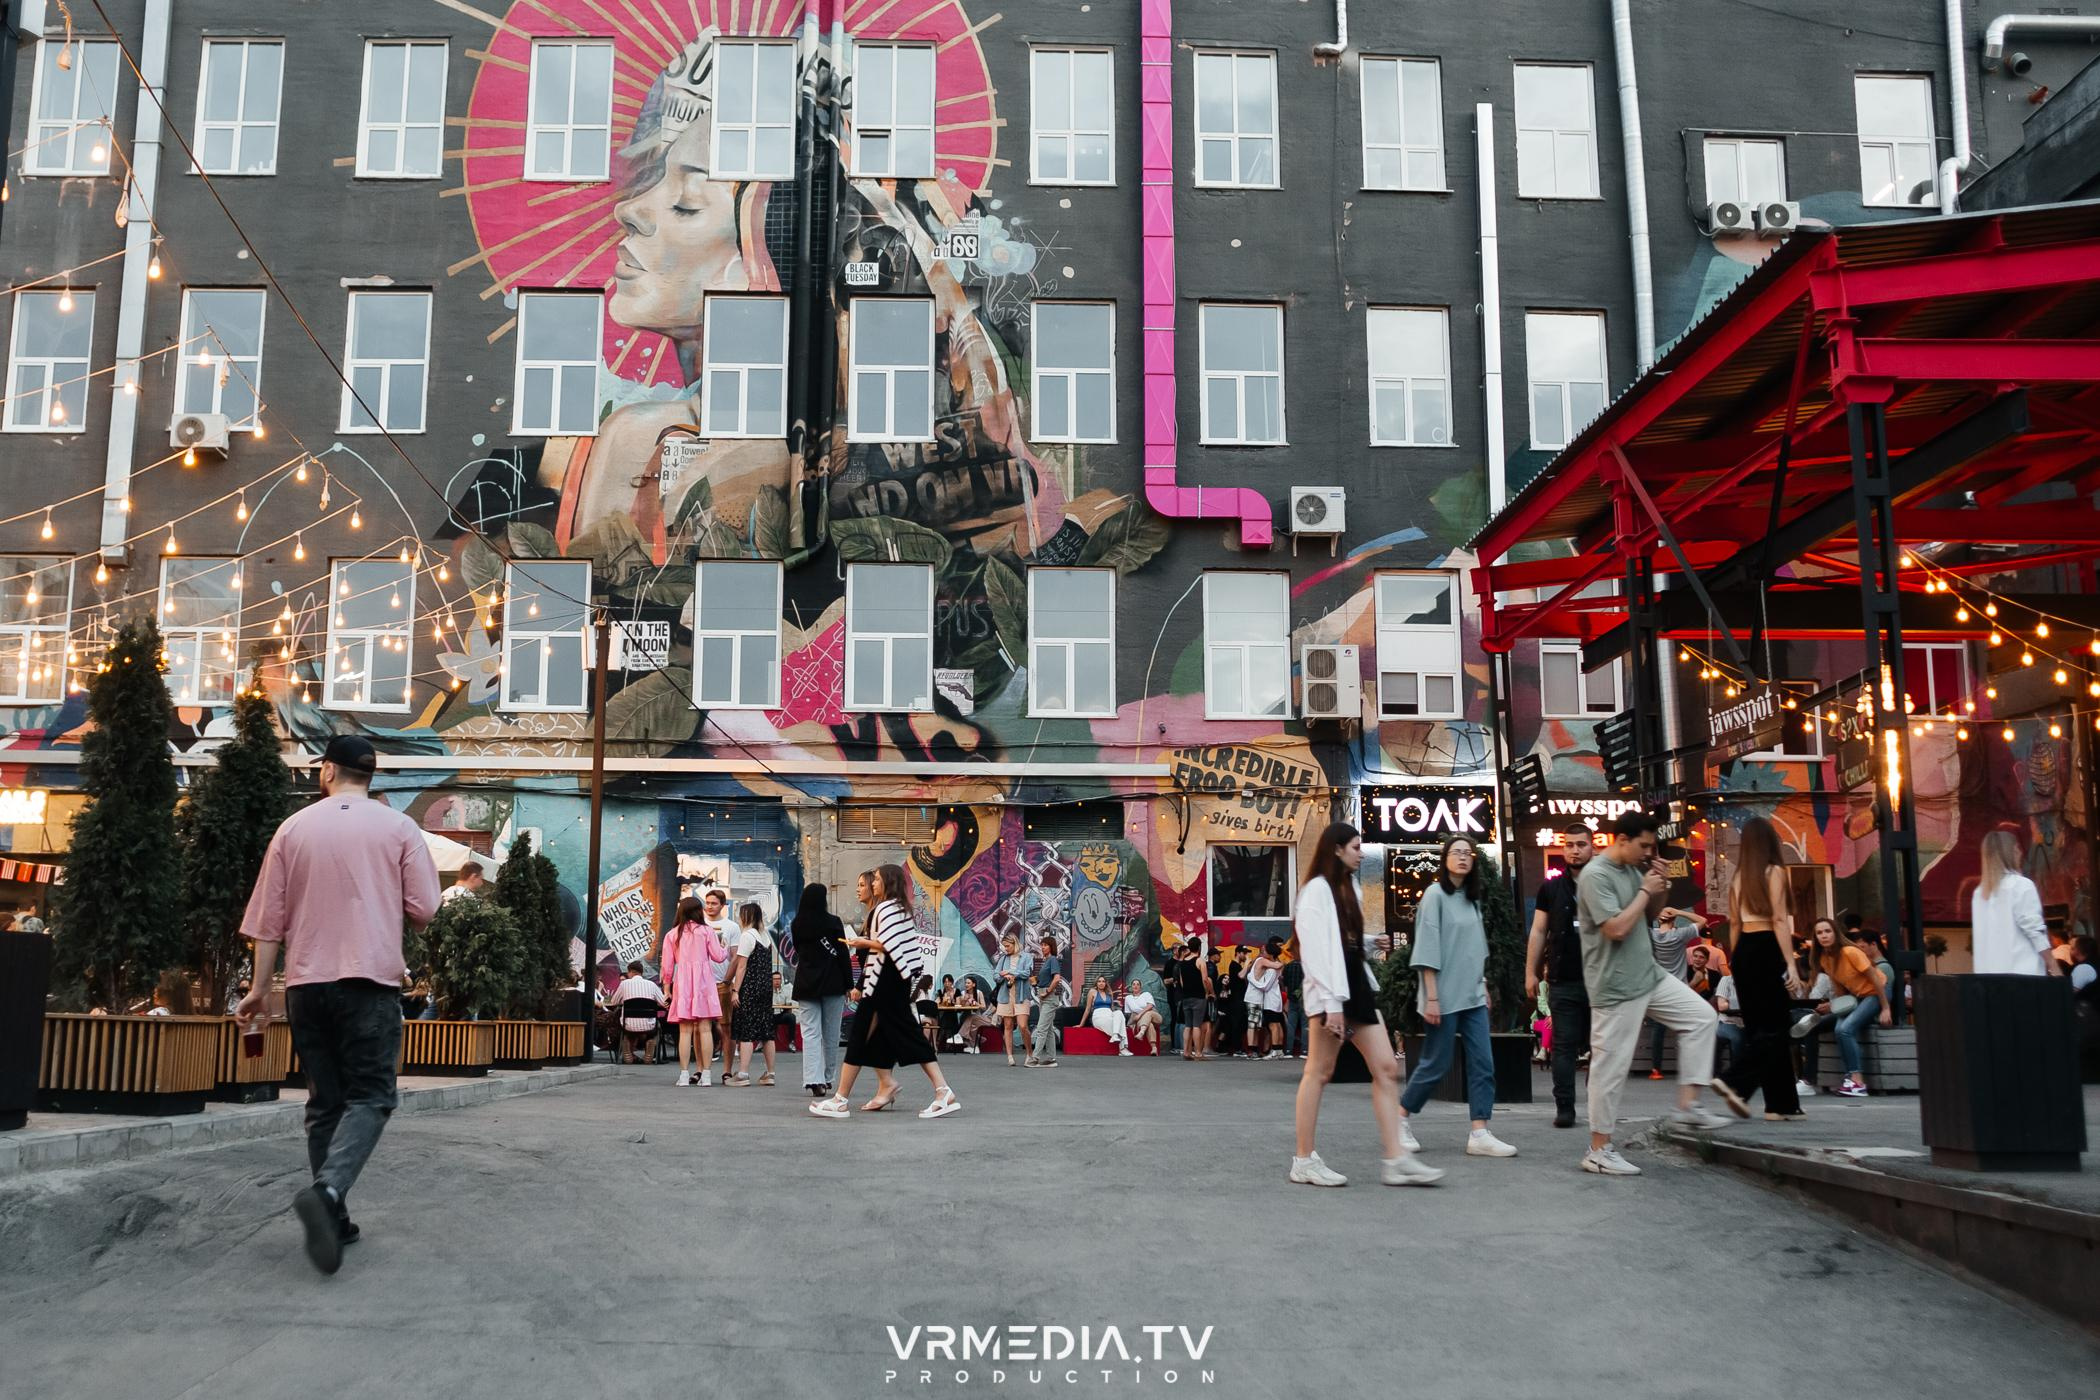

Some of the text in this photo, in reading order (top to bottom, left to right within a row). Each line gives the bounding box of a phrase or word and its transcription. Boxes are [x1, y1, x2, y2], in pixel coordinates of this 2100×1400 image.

[850, 264, 874, 272] BLACK
[846, 273, 878, 282] TUESDAY
[647, 623, 668, 637] THE
[632, 638, 667, 652] MOON
[1708, 685, 1774, 747] jawsspot
[1208, 809, 1295, 841] gives birth
[601, 893, 641, 924] WHO IS
[635, 901, 655, 920] THE
